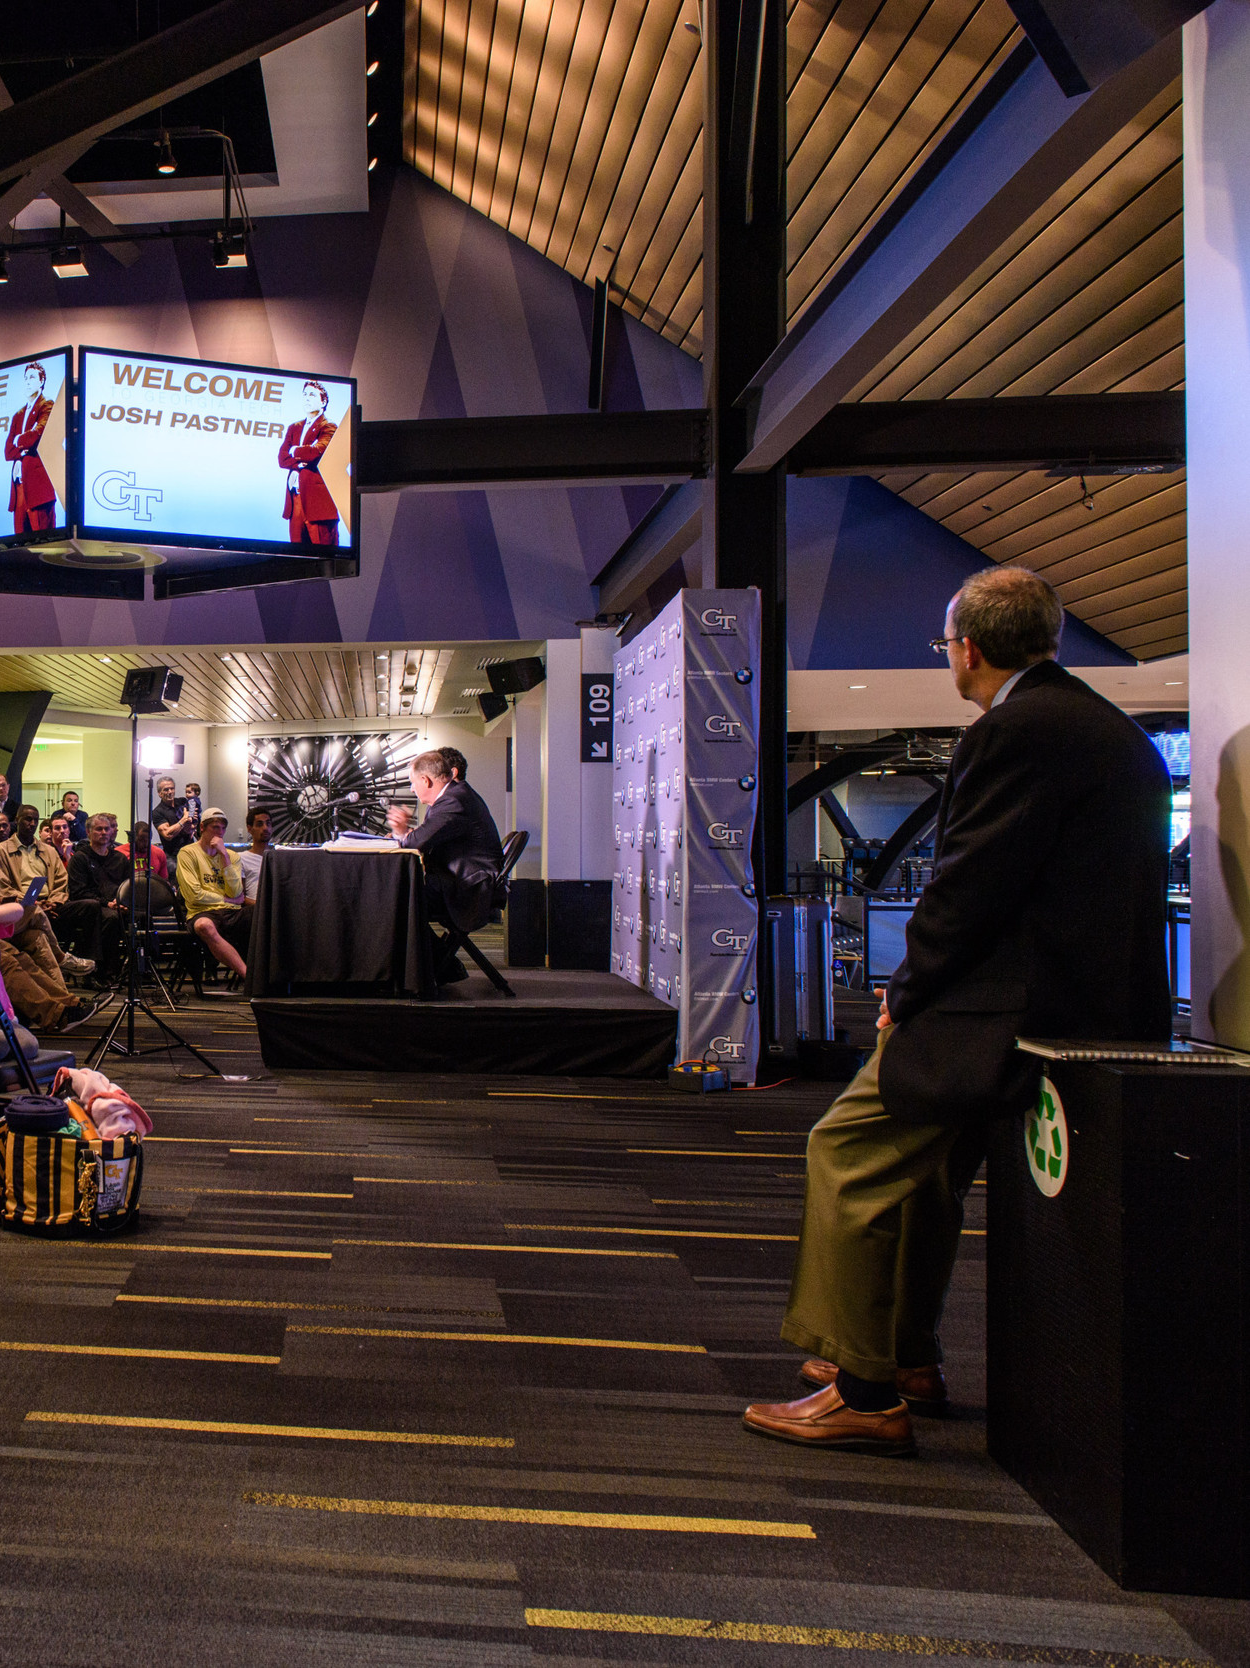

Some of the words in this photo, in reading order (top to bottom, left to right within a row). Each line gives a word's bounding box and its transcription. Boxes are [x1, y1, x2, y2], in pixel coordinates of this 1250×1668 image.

[113, 363, 285, 403] WELCOME
[90, 404, 163, 426] JOSH
[170, 412, 285, 439] PASTNER
[92, 469, 163, 522] GT
[700, 607, 737, 630] GT
[589, 684, 610, 726] 109
[705, 715, 742, 737] GT
[707, 822, 743, 844] GT
[711, 928, 748, 951] GT
[709, 1035, 745, 1058] GT
